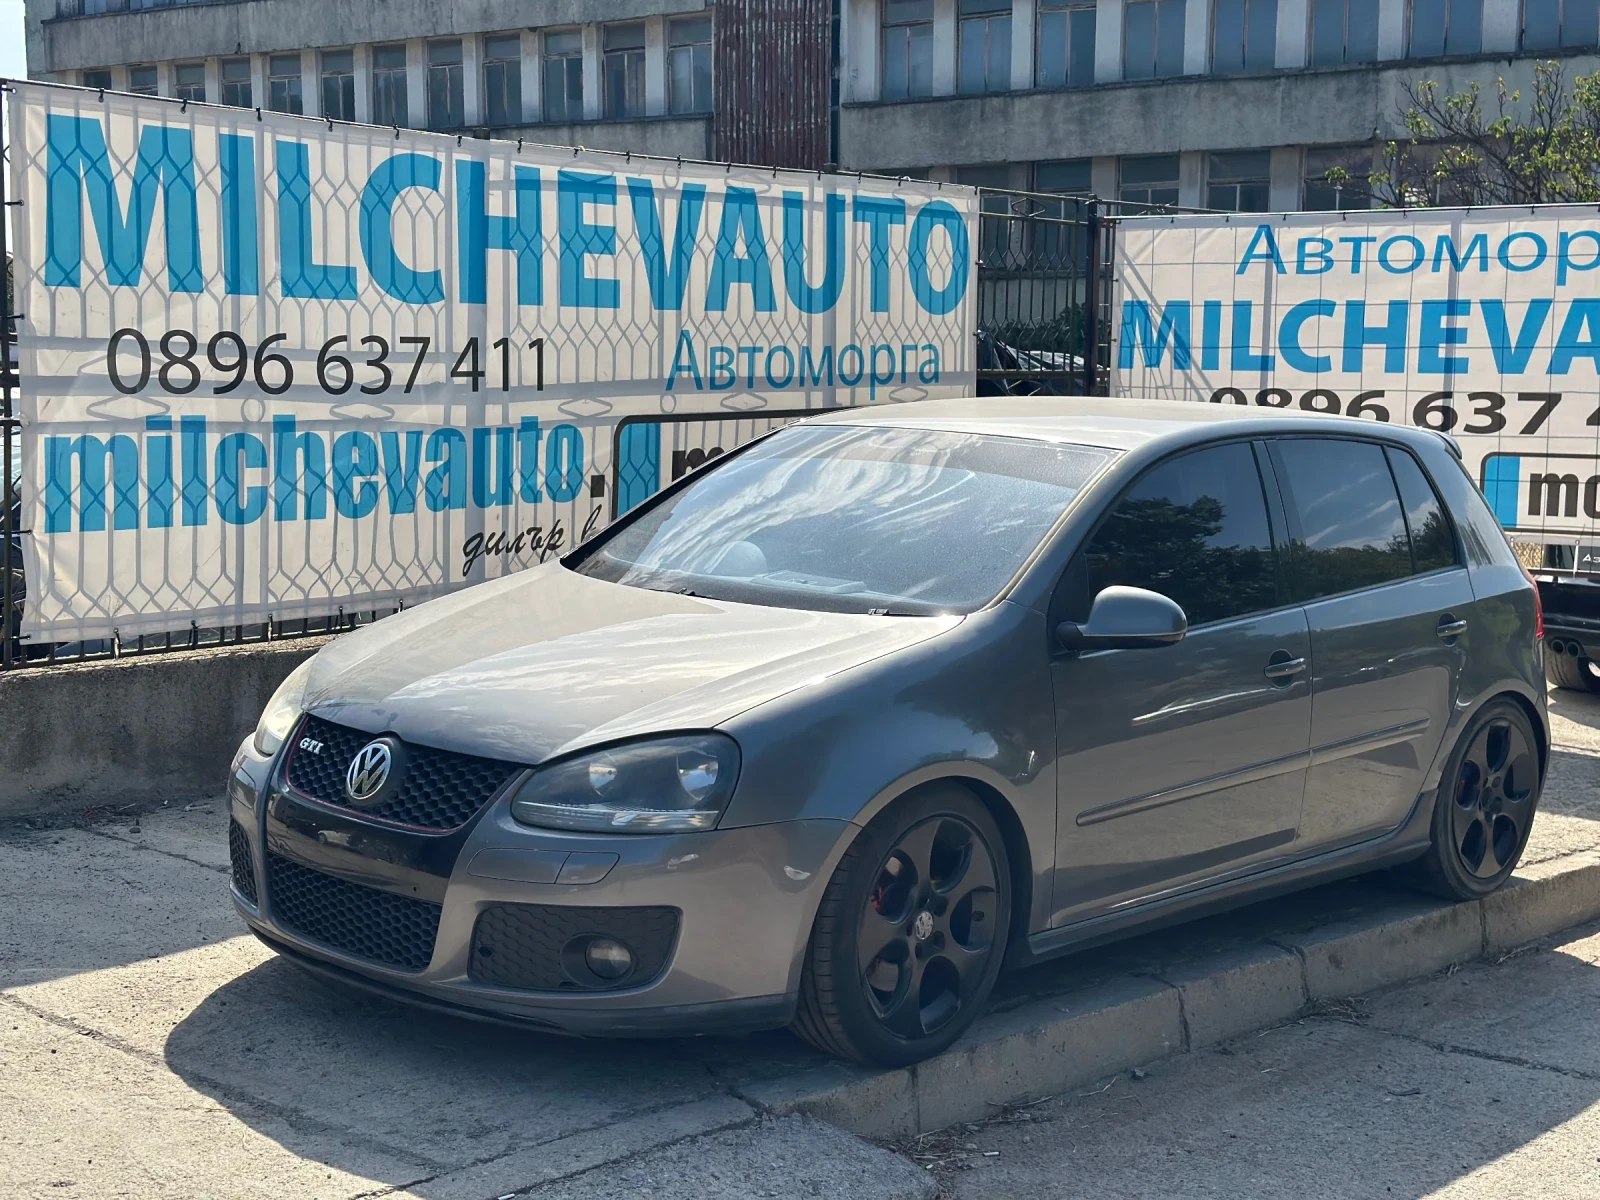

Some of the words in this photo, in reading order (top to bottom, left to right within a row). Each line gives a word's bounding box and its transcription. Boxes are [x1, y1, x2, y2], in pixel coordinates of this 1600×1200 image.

[45, 112, 970, 316] MILCHEVAUTO
[107, 328, 294, 395] 0896
[316, 335, 431, 395] 637
[449, 337, 544, 392] 411
[665, 329, 940, 401] Автоморга
[1118, 297, 1600, 375] MILCHEVA
[1412, 391, 1562, 435] 637
[44, 412, 605, 534] milchevauto.
[299, 737, 325, 755] GTI
[347, 743, 392, 800] VW
